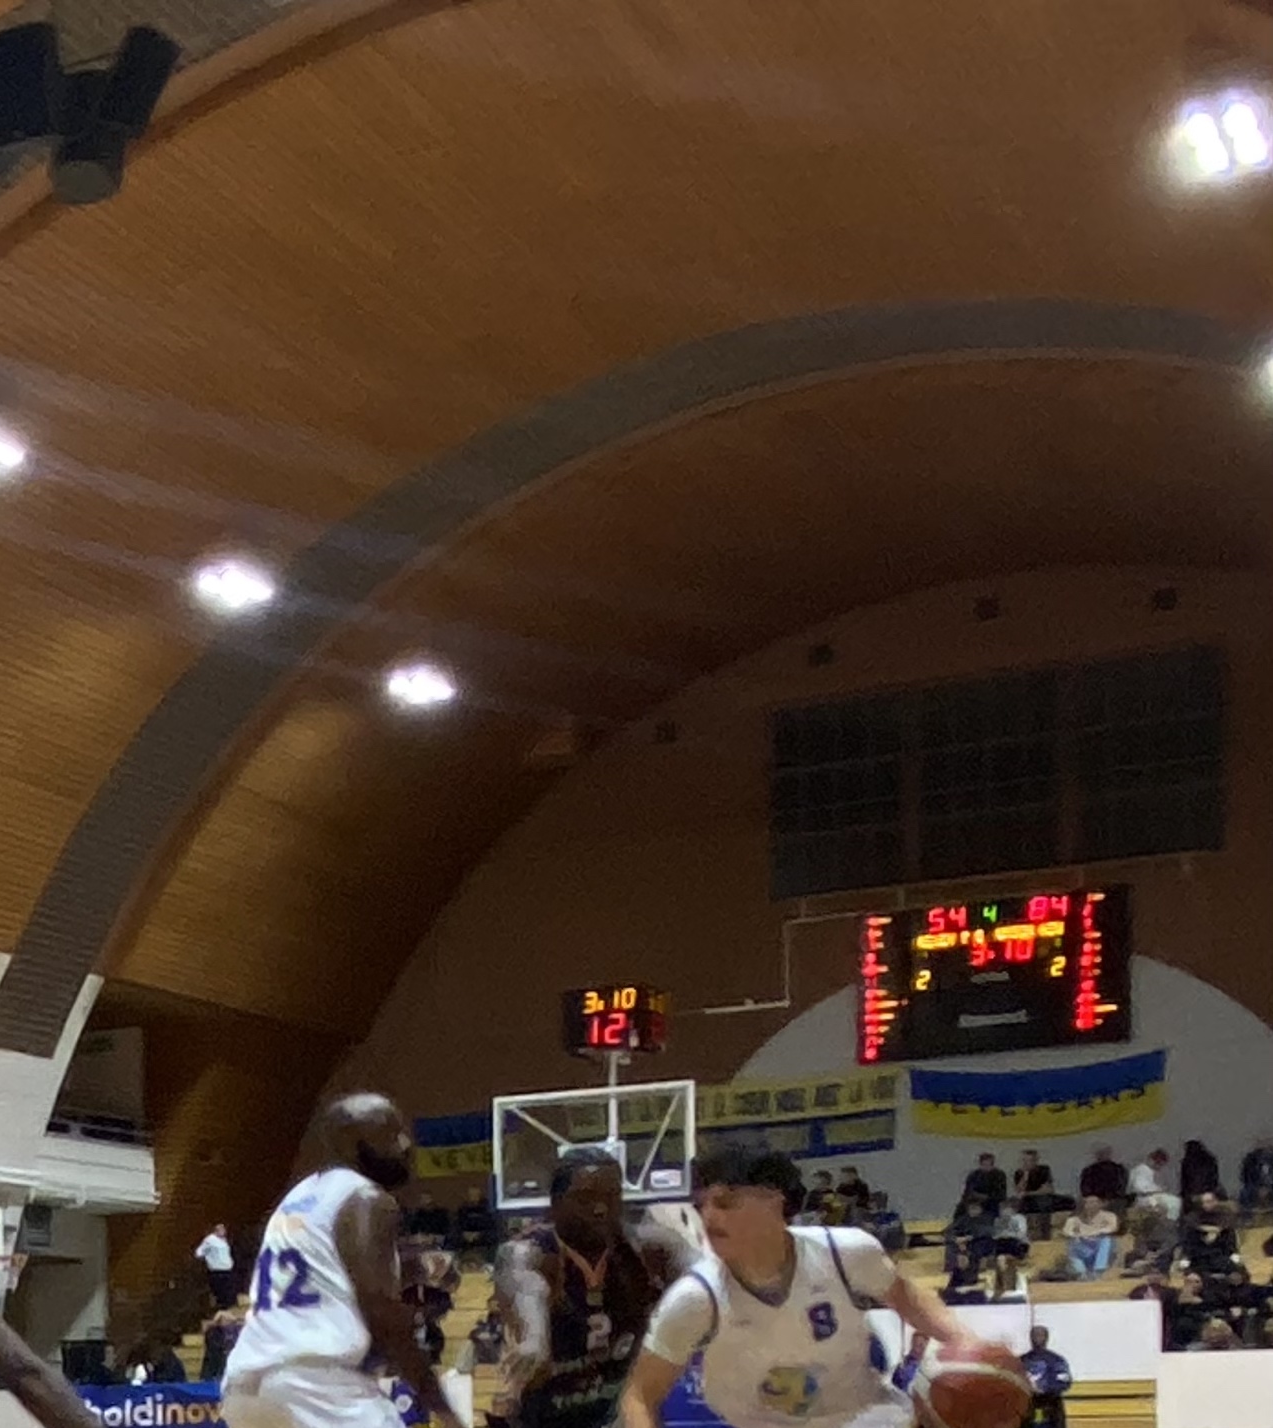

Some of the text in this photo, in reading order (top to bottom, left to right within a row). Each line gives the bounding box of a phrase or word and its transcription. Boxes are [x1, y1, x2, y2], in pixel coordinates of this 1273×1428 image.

[928, 906, 967, 933] 54
[982, 904, 999, 923] 4
[1028, 895, 1070, 922] 84
[915, 969, 931, 991] 2
[1050, 956, 1067, 977] 2
[590, 1013, 626, 1044] 12
[254, 1247, 322, 1311] 12
